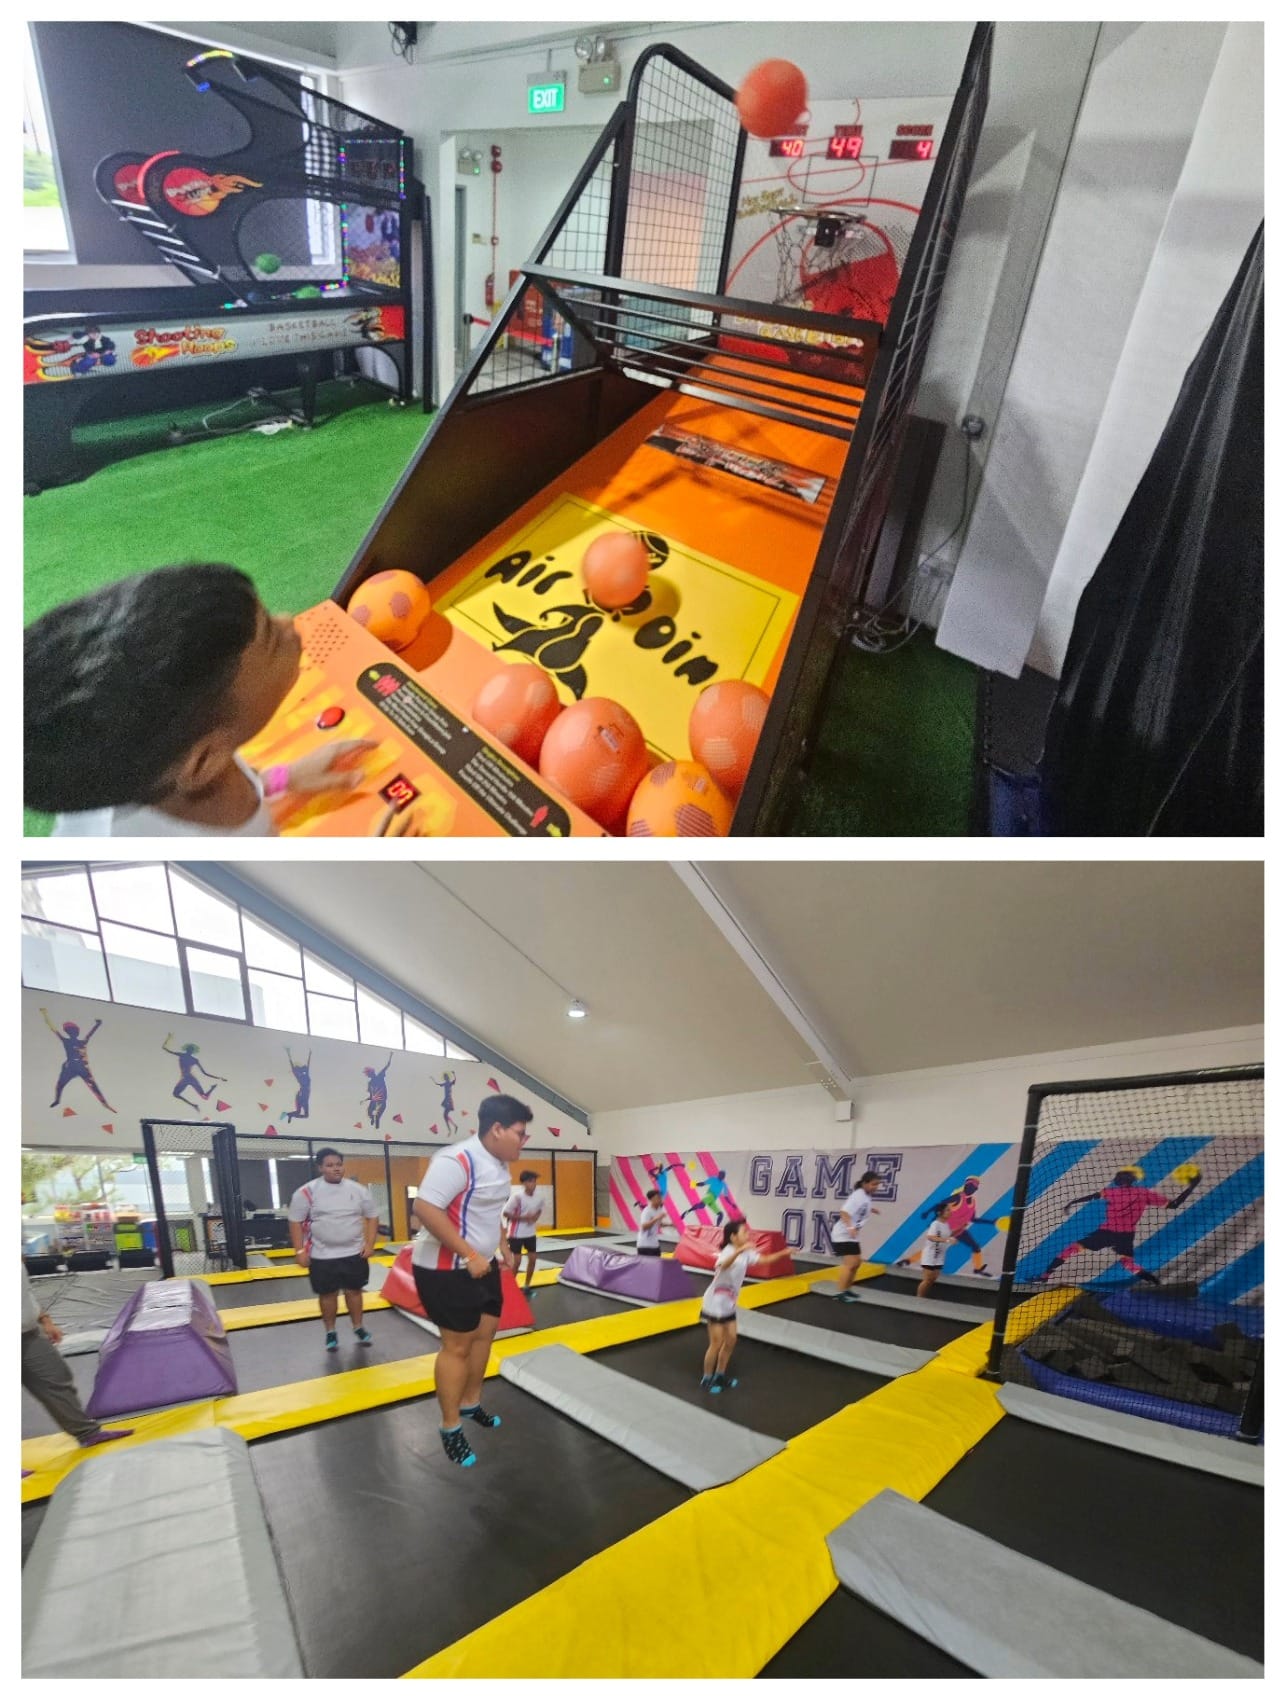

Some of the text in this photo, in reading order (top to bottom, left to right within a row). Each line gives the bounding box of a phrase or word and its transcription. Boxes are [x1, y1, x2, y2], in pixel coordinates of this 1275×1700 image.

[533, 87, 559, 109] EXIT
[781, 140, 804, 157] 40
[830, 137, 862, 158] 49
[916, 141, 933, 159] 4
[133, 325, 226, 345] Shooting
[484, 550, 573, 595] Air
[750, 1153, 904, 1202] GAME
